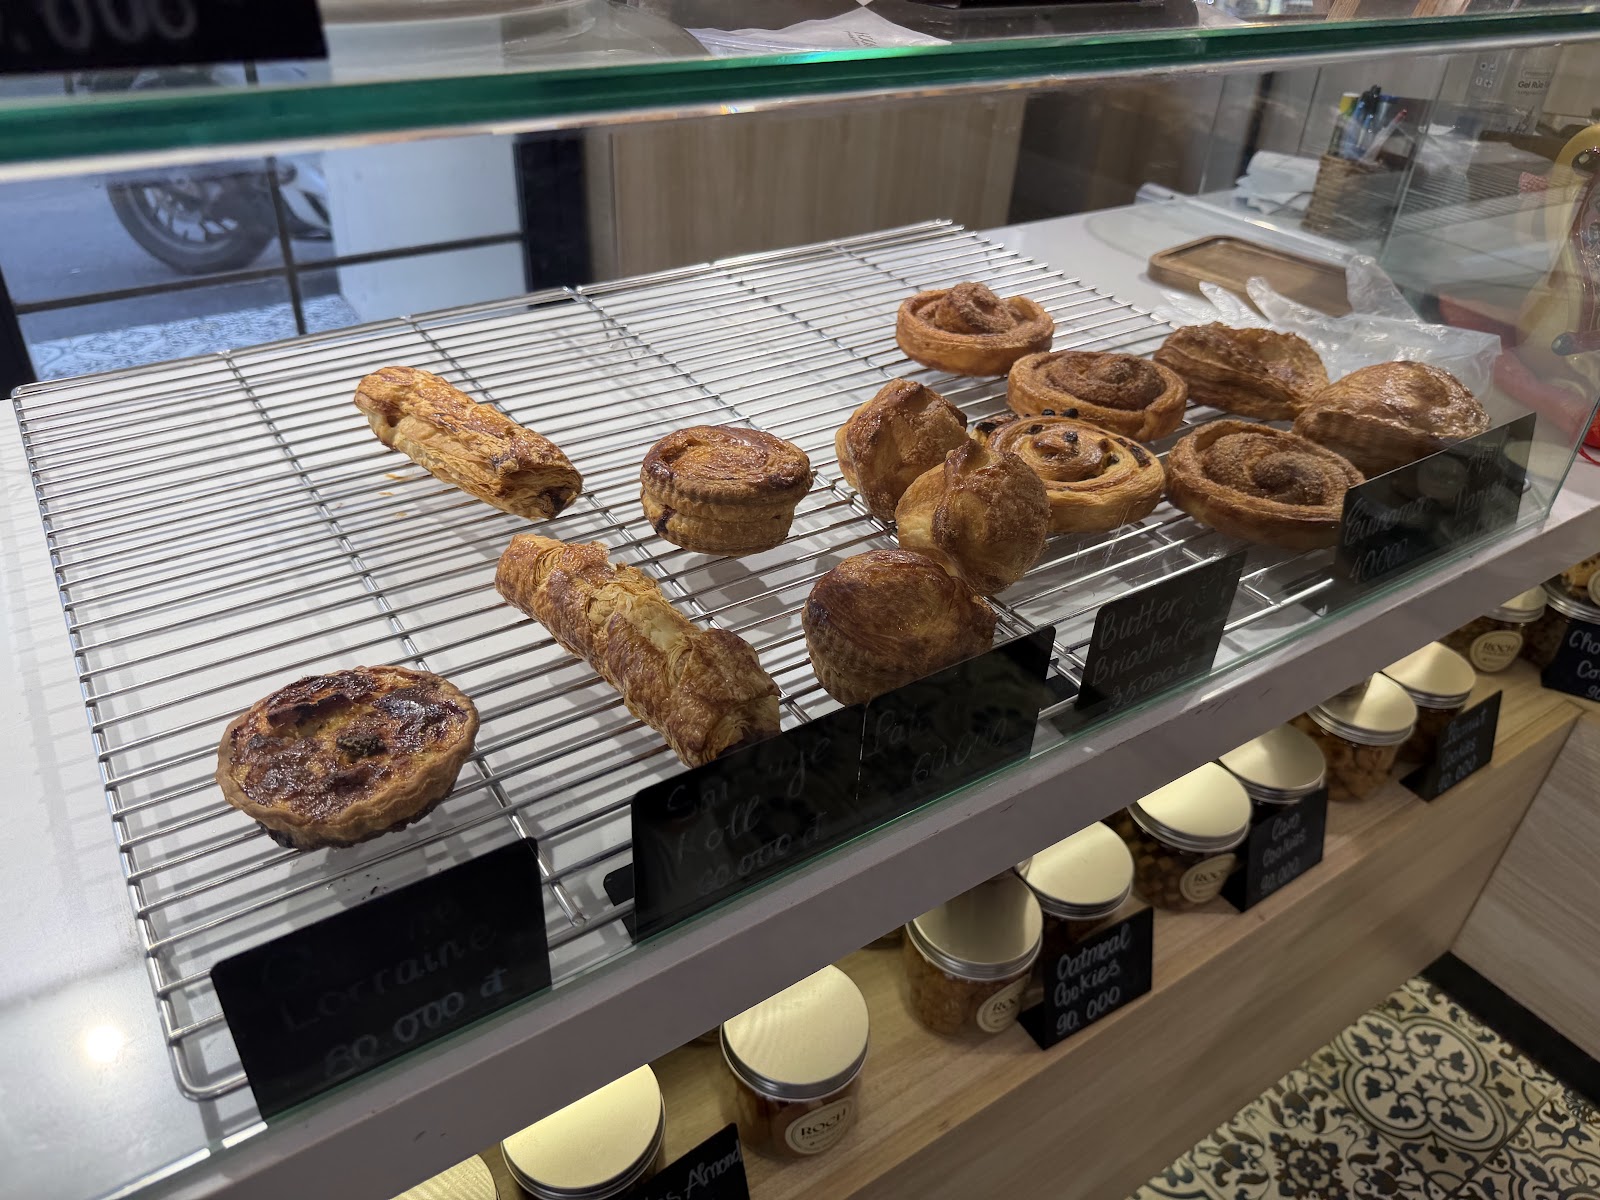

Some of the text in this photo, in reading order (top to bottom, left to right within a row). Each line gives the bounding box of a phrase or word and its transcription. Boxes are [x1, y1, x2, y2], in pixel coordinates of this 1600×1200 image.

[1099, 595, 1185, 650] Butter
[1057, 922, 1131, 981] Oatmeal
[1054, 958, 1121, 1007] Cookies
